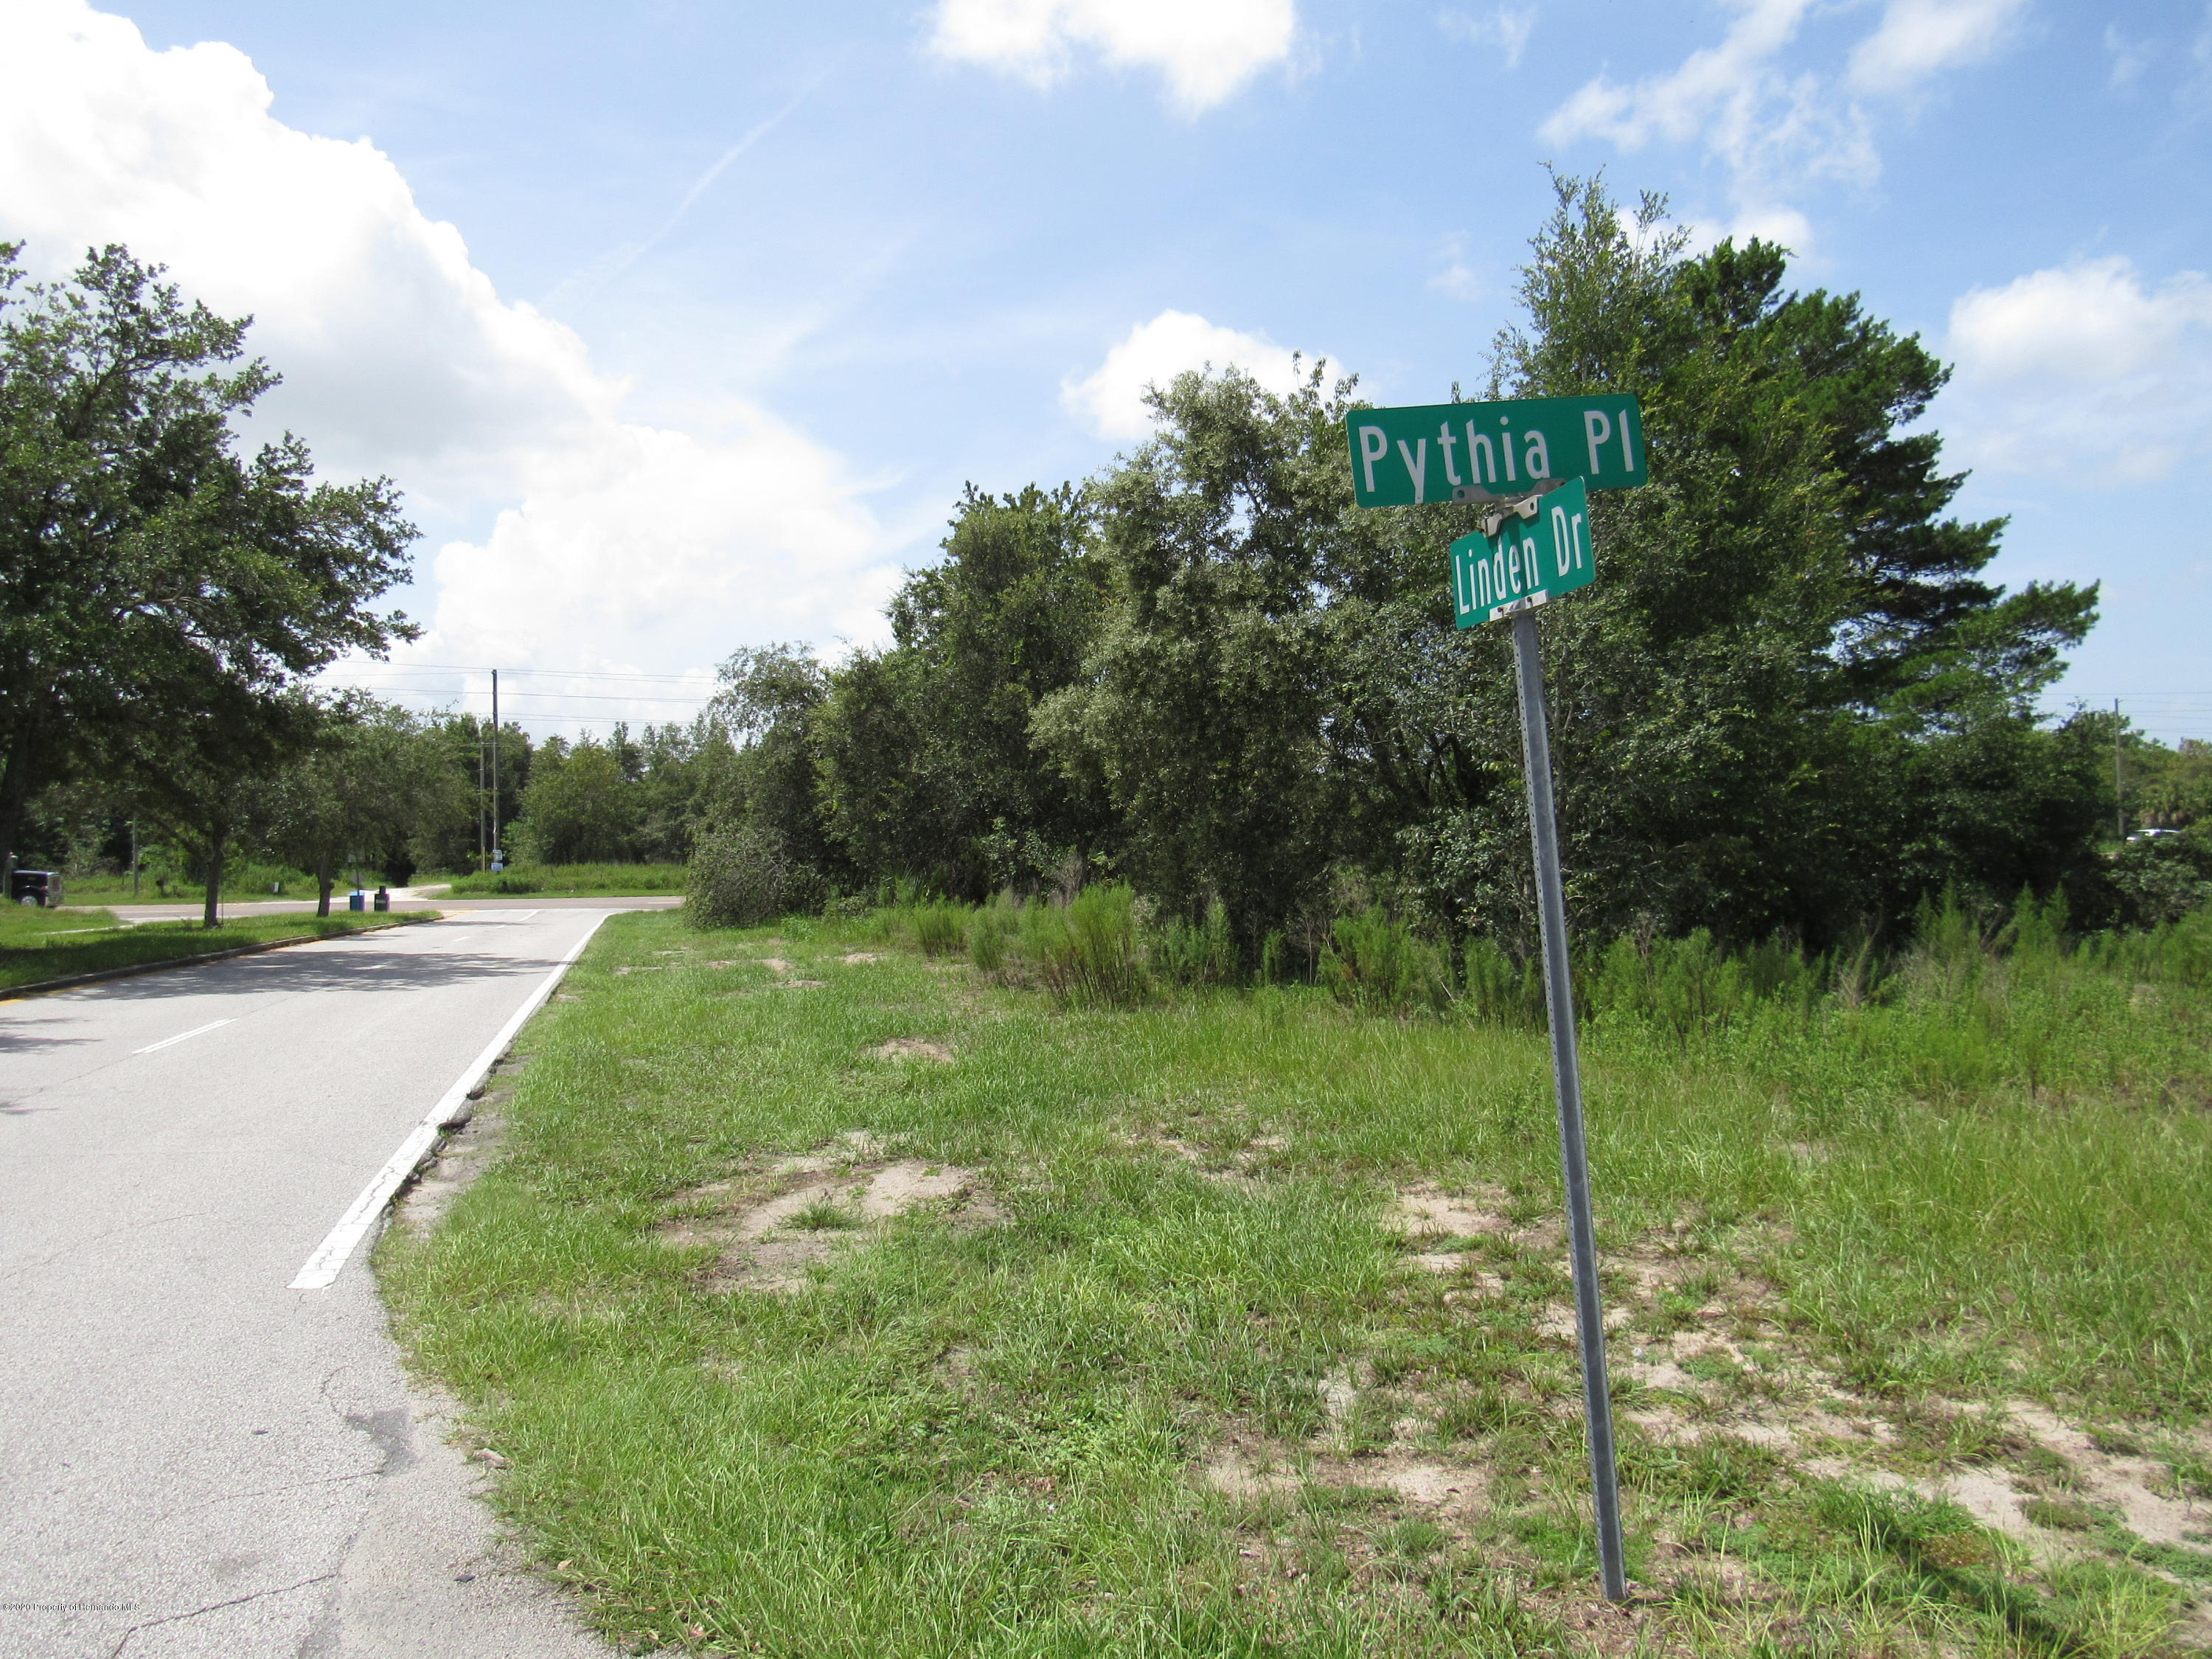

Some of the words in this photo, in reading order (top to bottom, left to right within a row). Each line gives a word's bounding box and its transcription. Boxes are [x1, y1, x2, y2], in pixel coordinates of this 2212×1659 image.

[1358, 416, 1549, 504] Pythia
[1583, 408, 1635, 475] Pl
[1455, 535, 1540, 615] Linden
[1551, 506, 1582, 577] Dr
